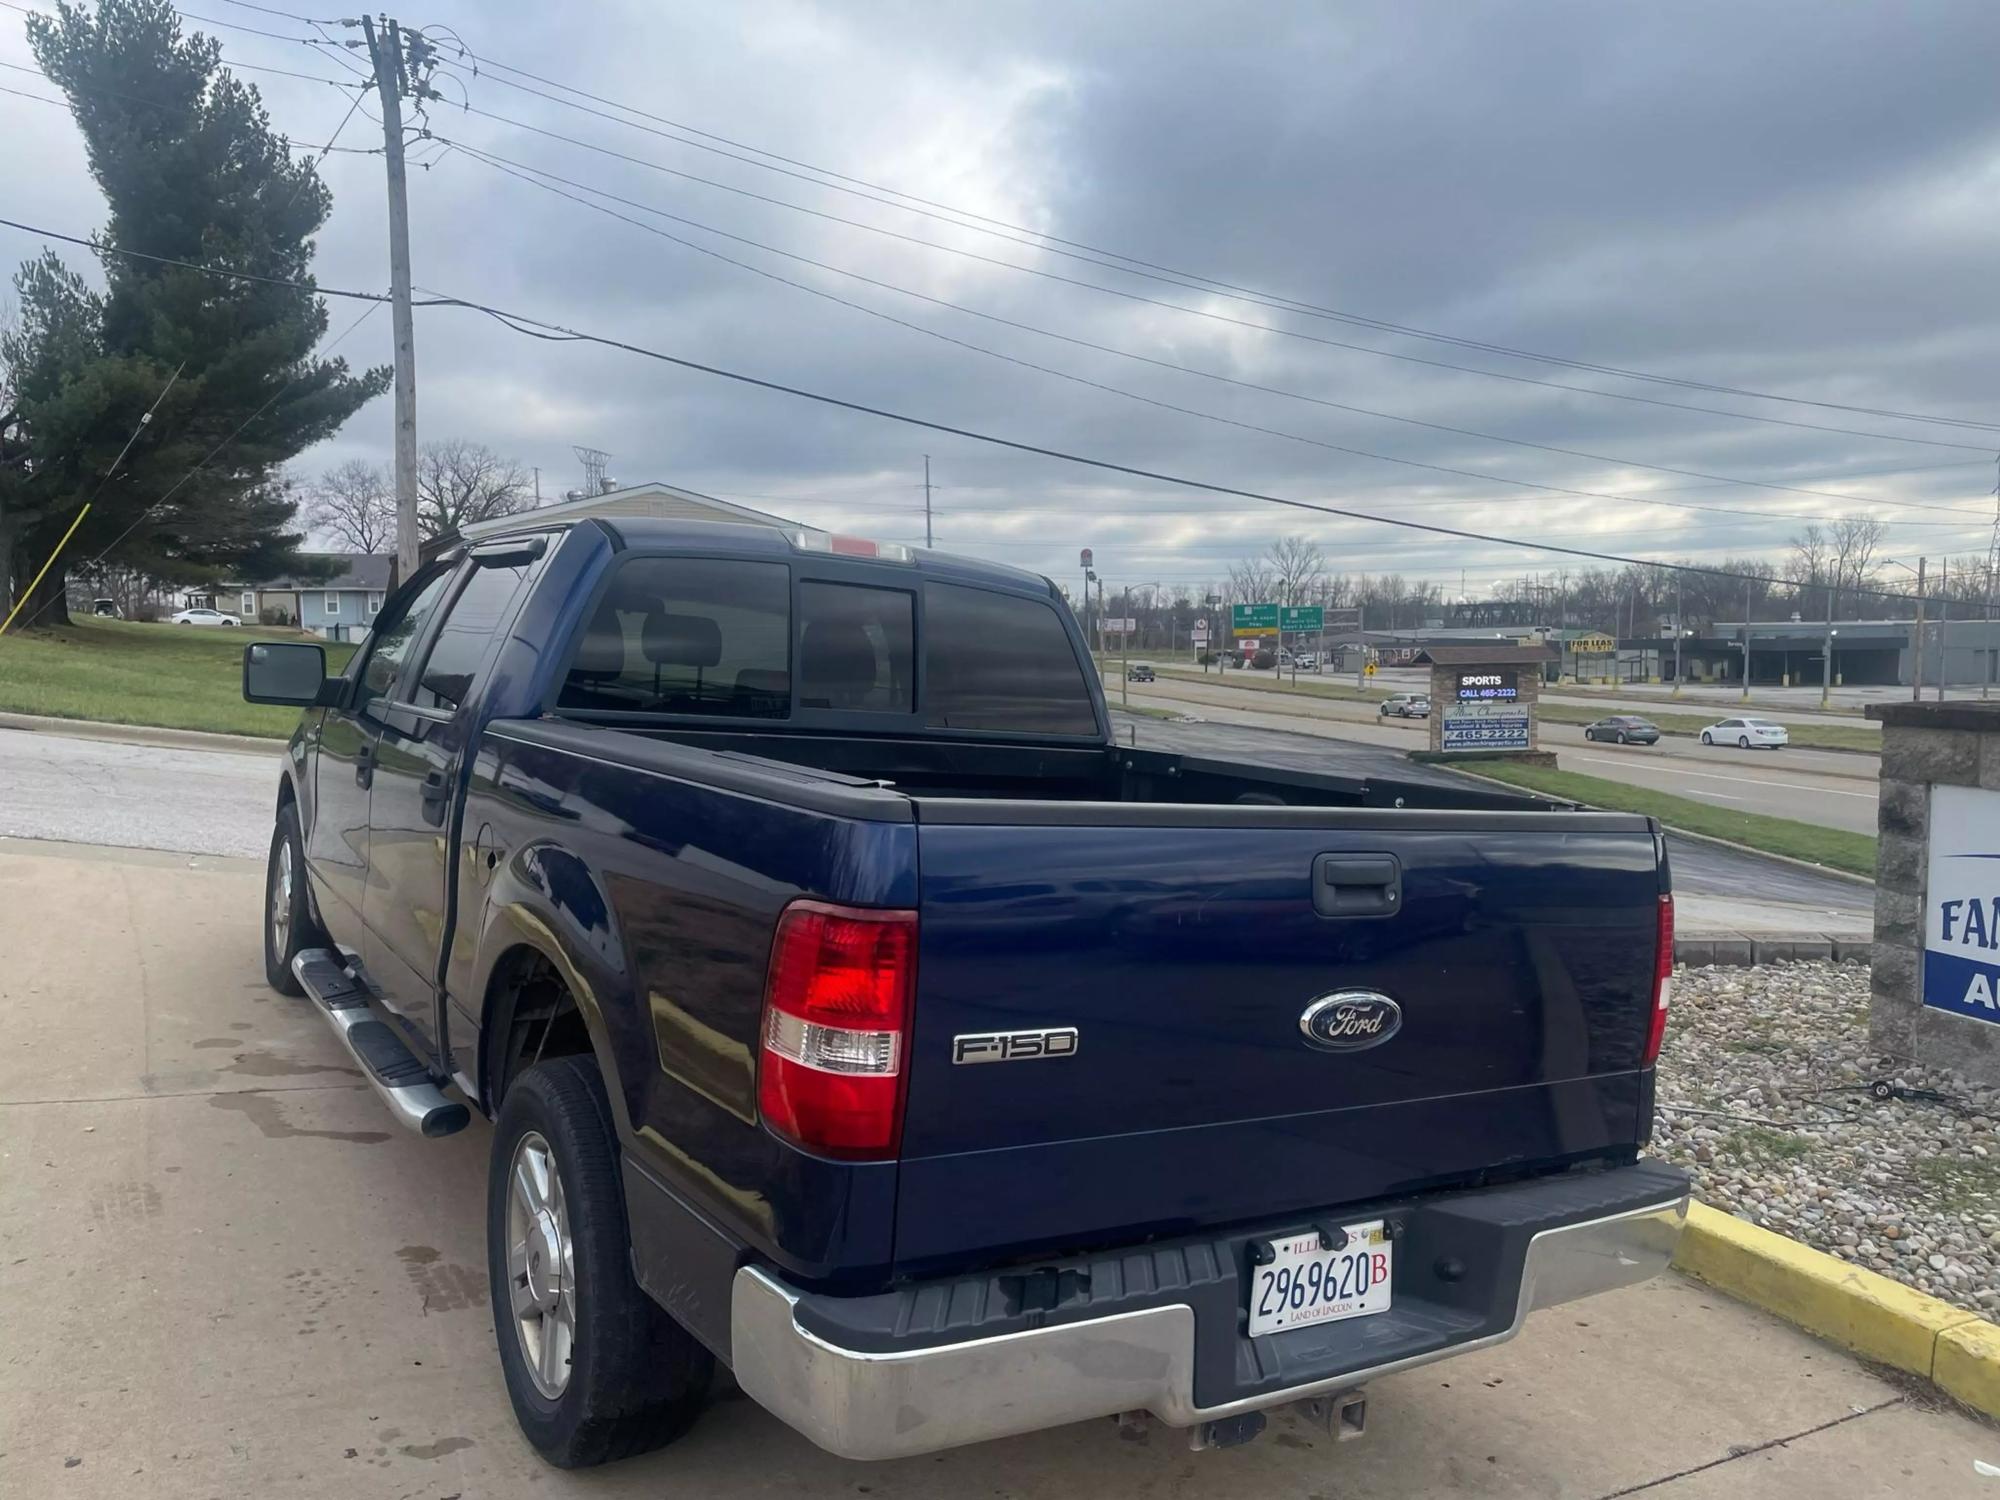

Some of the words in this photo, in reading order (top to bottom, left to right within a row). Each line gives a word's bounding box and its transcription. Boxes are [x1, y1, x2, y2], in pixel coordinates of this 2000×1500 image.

[1591, 639, 1613, 647] LEAS
[1462, 676, 1502, 686] SPORTS
[1460, 689, 1479, 698] CALL
[1480, 688, 1517, 697] 465-2222
[1455, 729, 1526, 739] 465-2222
[1963, 972, 2000, 1010] A
[1329, 1004, 1384, 1037] Ford
[956, 1031, 1076, 1062] F-150
